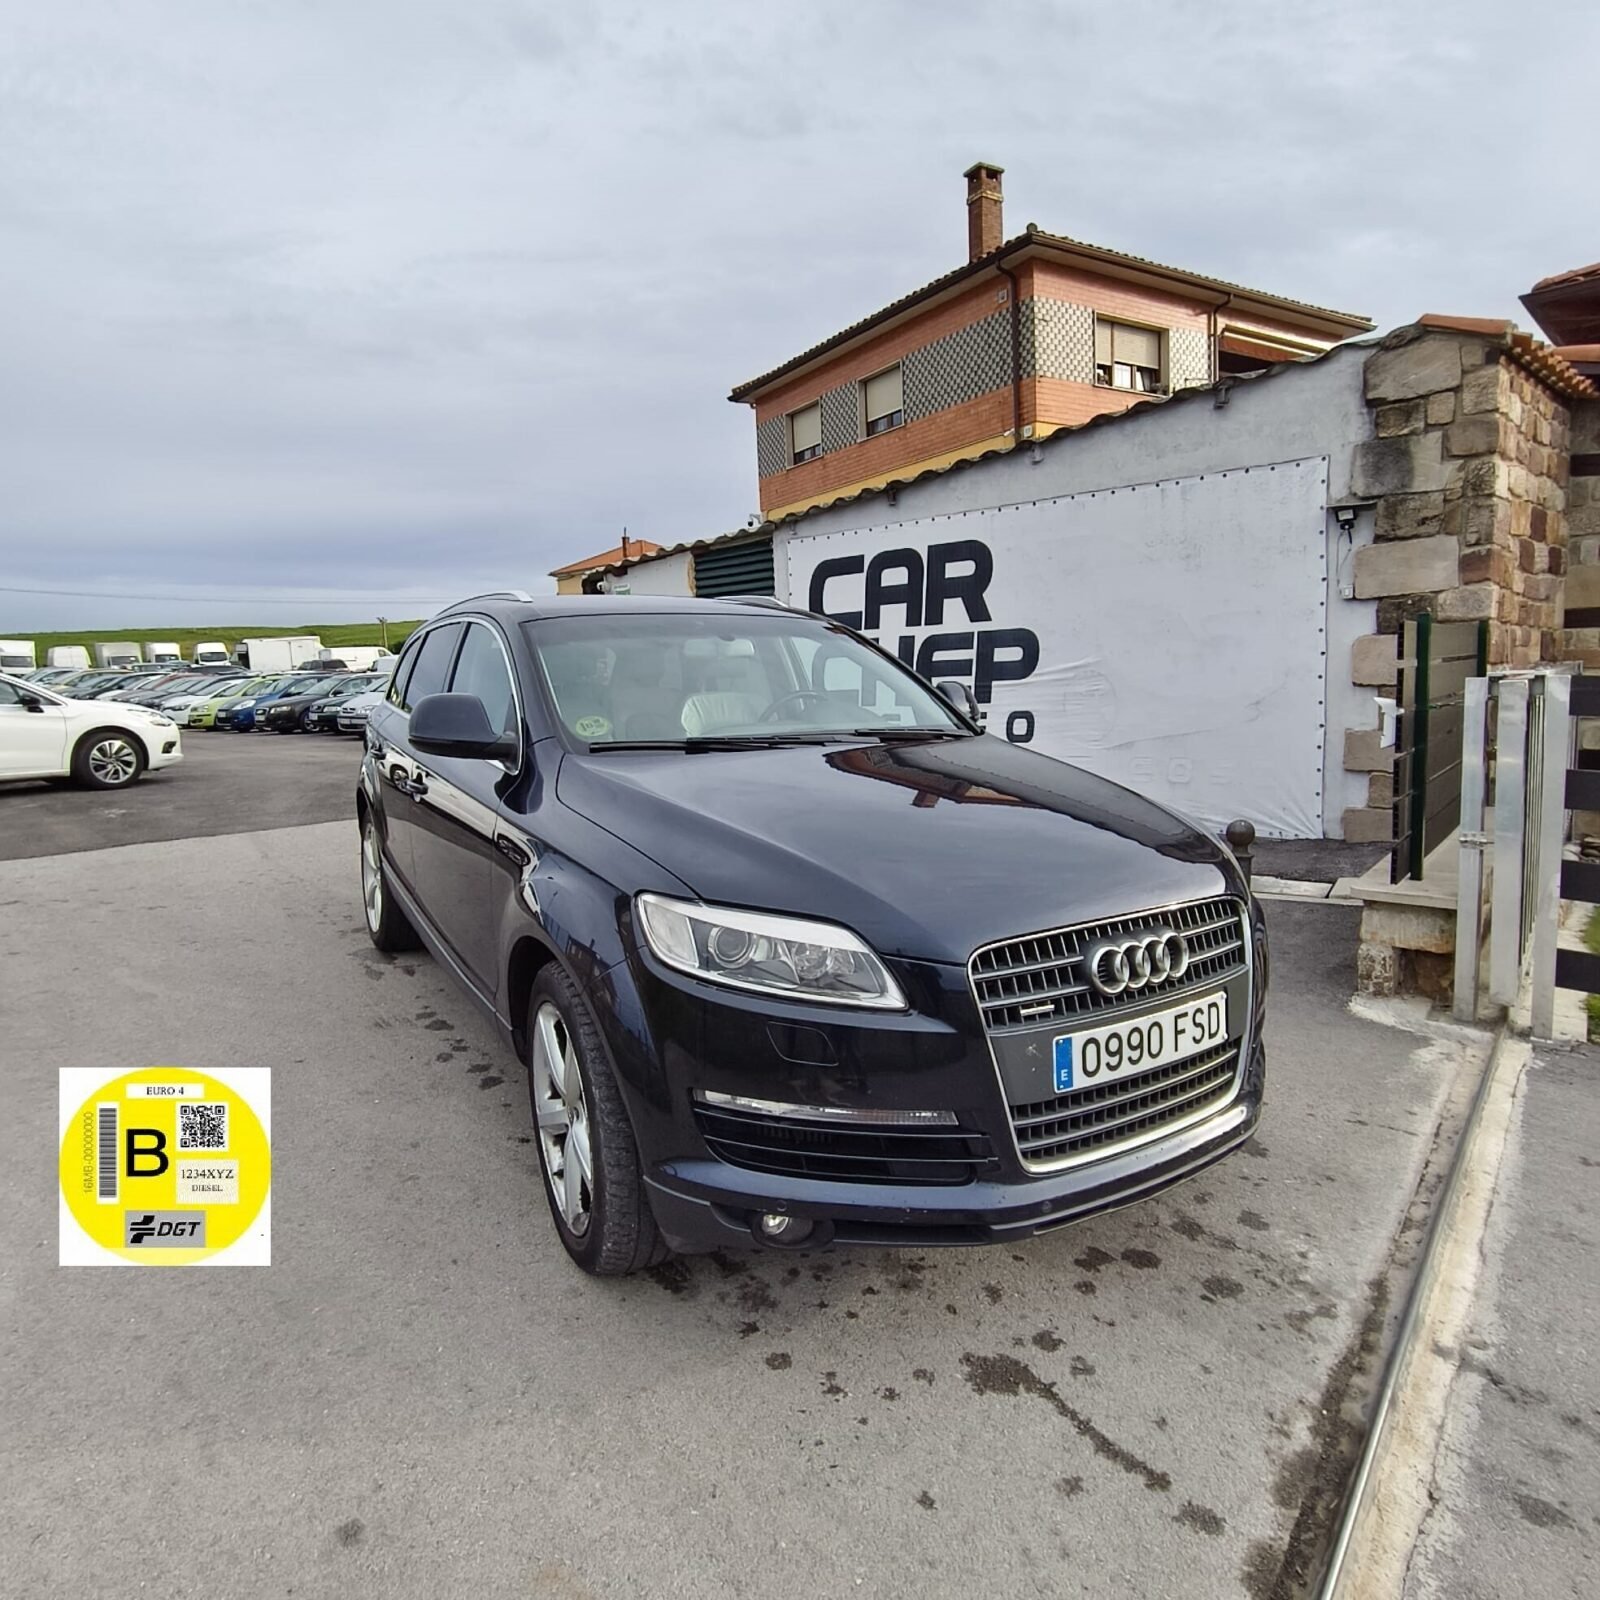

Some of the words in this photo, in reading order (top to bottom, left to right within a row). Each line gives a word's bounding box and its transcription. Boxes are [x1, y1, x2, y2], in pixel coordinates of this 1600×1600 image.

[809, 539, 993, 632] CAR
[1060, 1069, 1068, 1081] E
[1081, 1021, 1163, 1078] 0990
[1174, 1001, 1220, 1053] FSD
